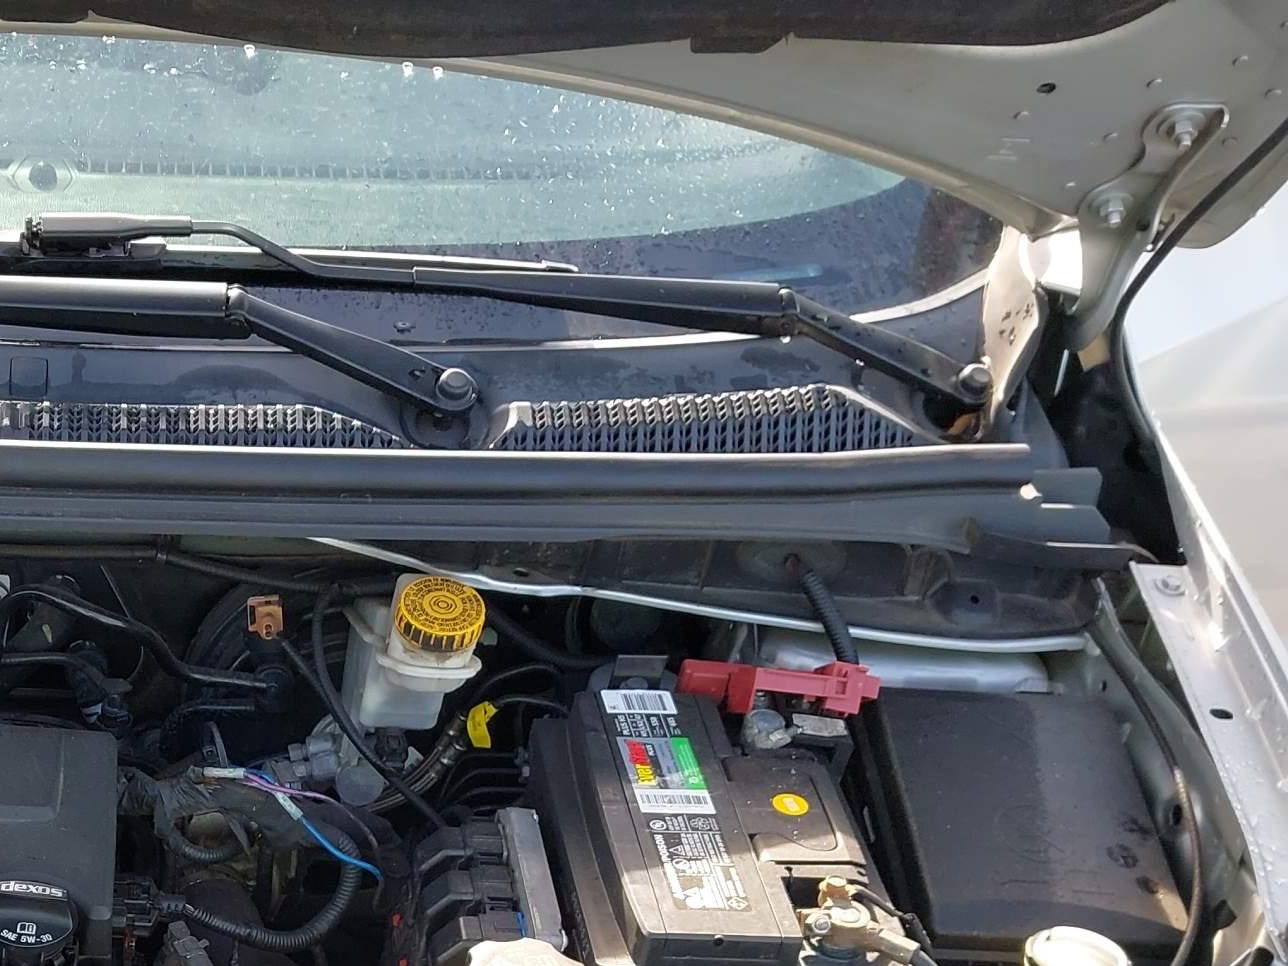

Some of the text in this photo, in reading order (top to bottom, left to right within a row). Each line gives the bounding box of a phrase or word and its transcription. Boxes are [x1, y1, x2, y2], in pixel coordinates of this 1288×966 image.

[0, 881, 63, 897] dexos
[0, 929, 52, 943] SAE 5W-30
